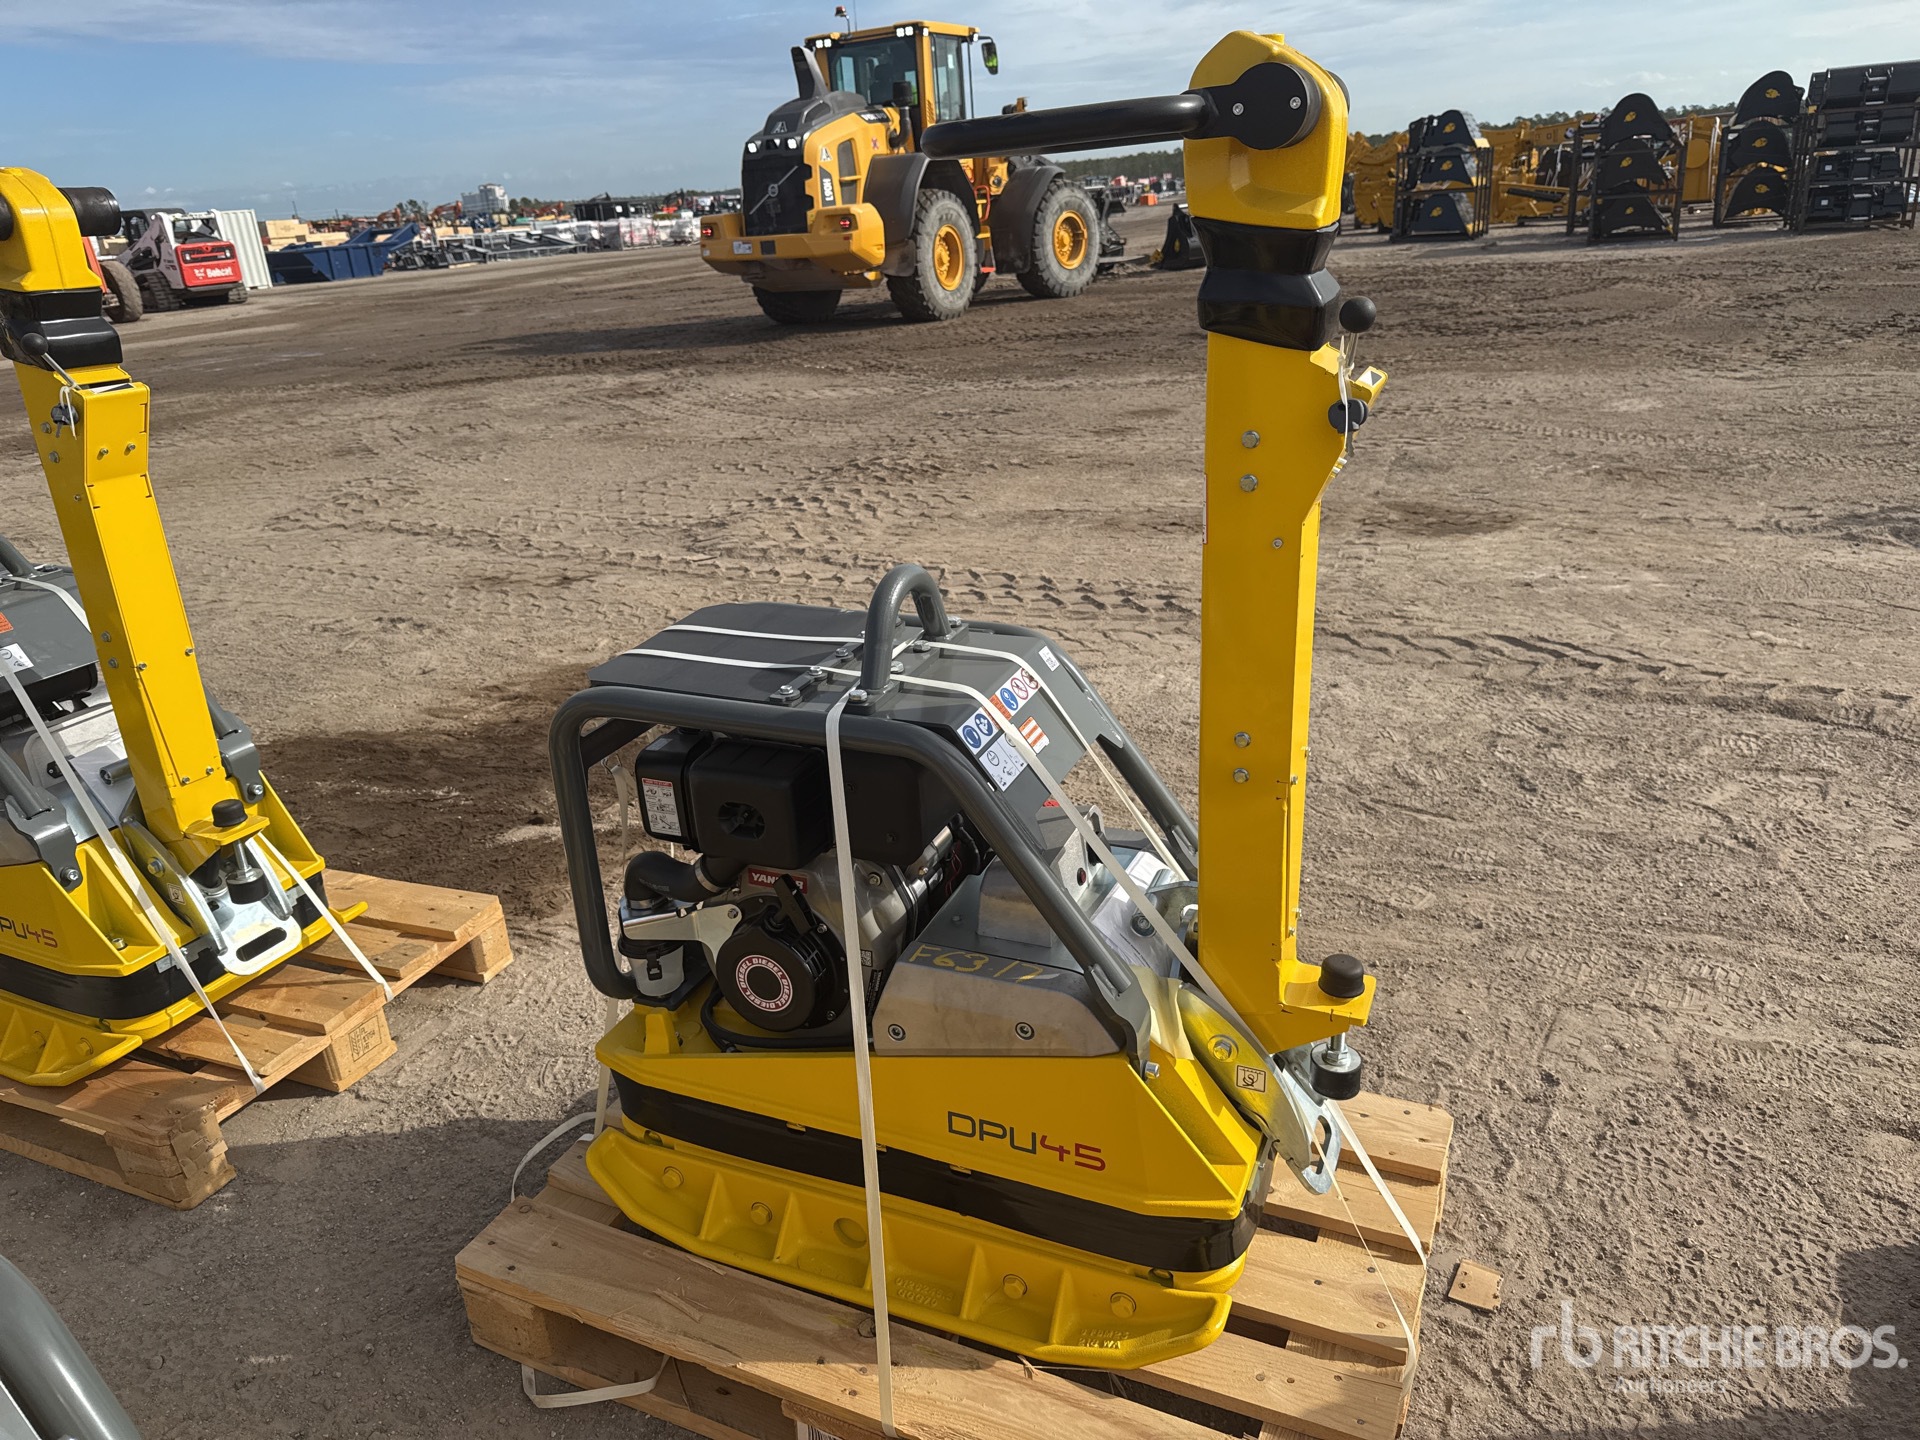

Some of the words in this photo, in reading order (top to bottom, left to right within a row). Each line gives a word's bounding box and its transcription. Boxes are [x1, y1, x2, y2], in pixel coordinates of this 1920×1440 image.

[822, 178, 834, 202] L90H
[206, 267, 233, 278] Bobcat
[751, 872, 804, 890] YANR
[739, 960, 752, 989] DIESEL
[752, 957, 783, 978] DIESEL
[745, 988, 776, 1009] DIESEL
[776, 979, 790, 1006] DIESEL
[947, 1110, 1106, 1172] DPU45
